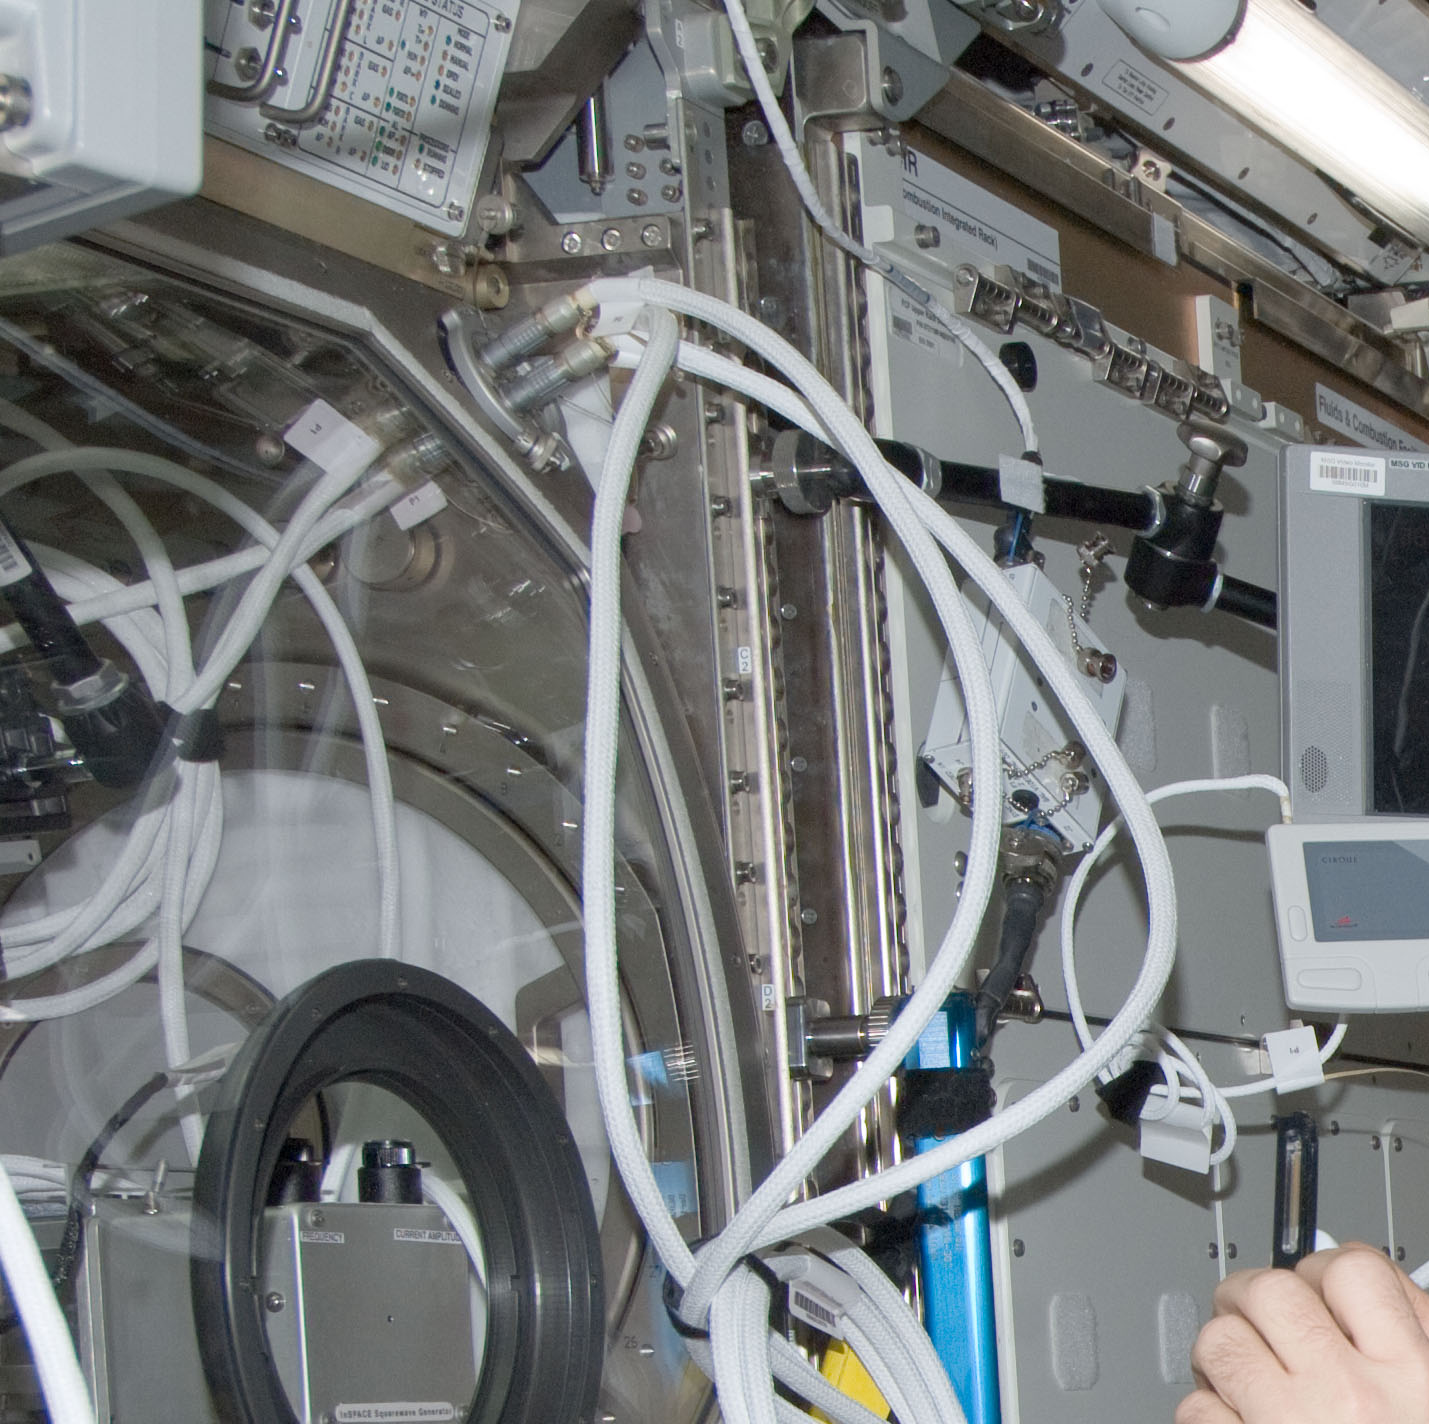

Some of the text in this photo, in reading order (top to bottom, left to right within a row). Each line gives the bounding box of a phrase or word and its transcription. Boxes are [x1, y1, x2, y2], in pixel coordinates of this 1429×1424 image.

[942, 205, 977, 237] Integrated
[1319, 397, 1343, 423] Fluids
[1345, 413, 1353, 428] &
[1353, 417, 1398, 450] Combustion
[1391, 459, 1410, 469] MSG
[1411, 460, 1426, 470] VID
[1321, 856, 1359, 864] CIRQUE
[302, 1232, 343, 1243] FREQUENCY
[396, 1229, 462, 1242] CURRENT AMPLITU
[374, 1407, 416, 1419] Squarewave
[418, 1406, 453, 1417] Generator
